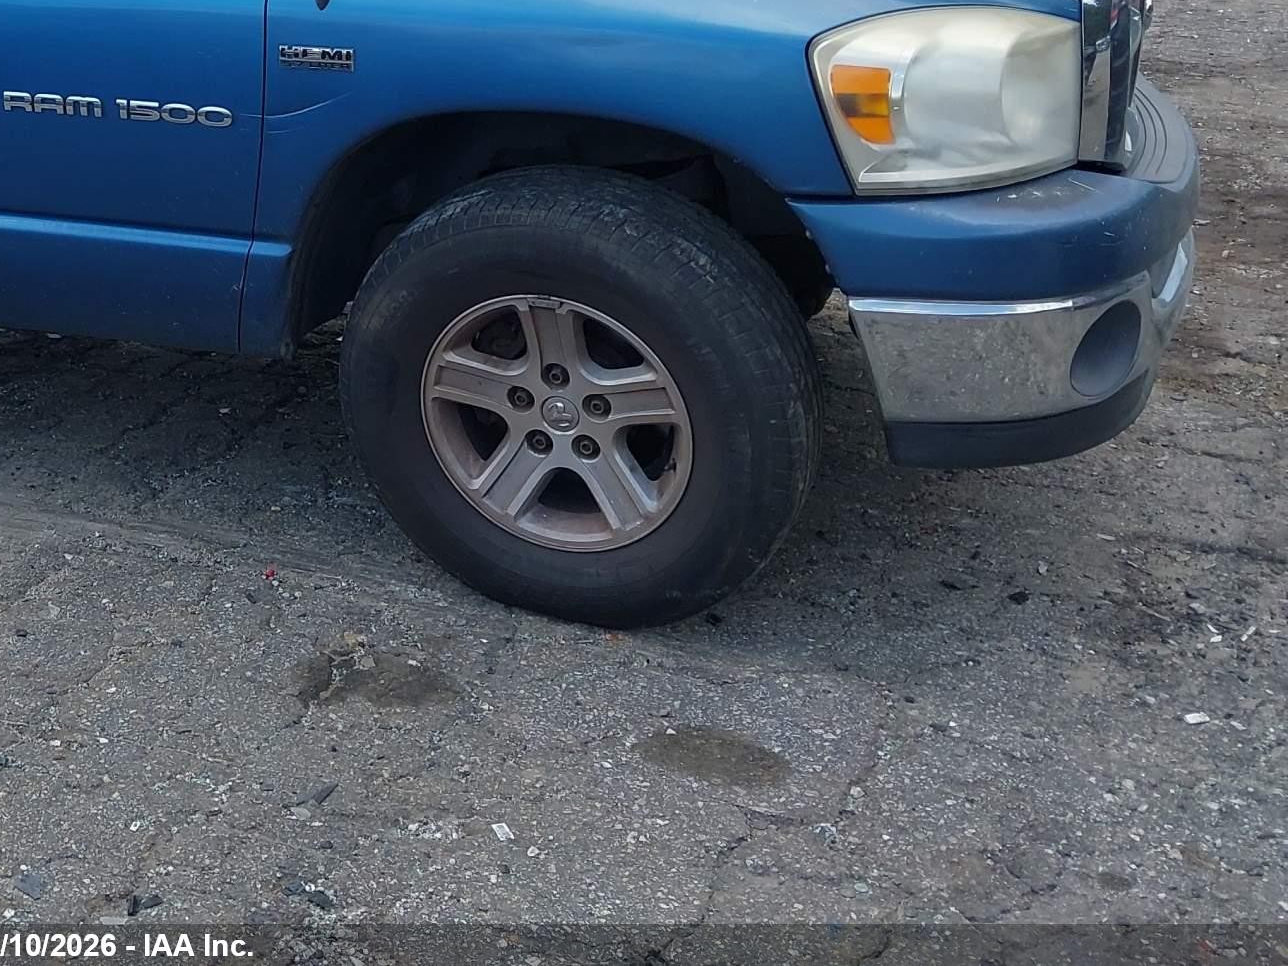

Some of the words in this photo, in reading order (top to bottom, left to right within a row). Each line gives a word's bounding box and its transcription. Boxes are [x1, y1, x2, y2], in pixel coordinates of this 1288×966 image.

[279, 45, 353, 62] HEMI
[3, 90, 103, 118] RAM
[115, 98, 233, 127] 1500
